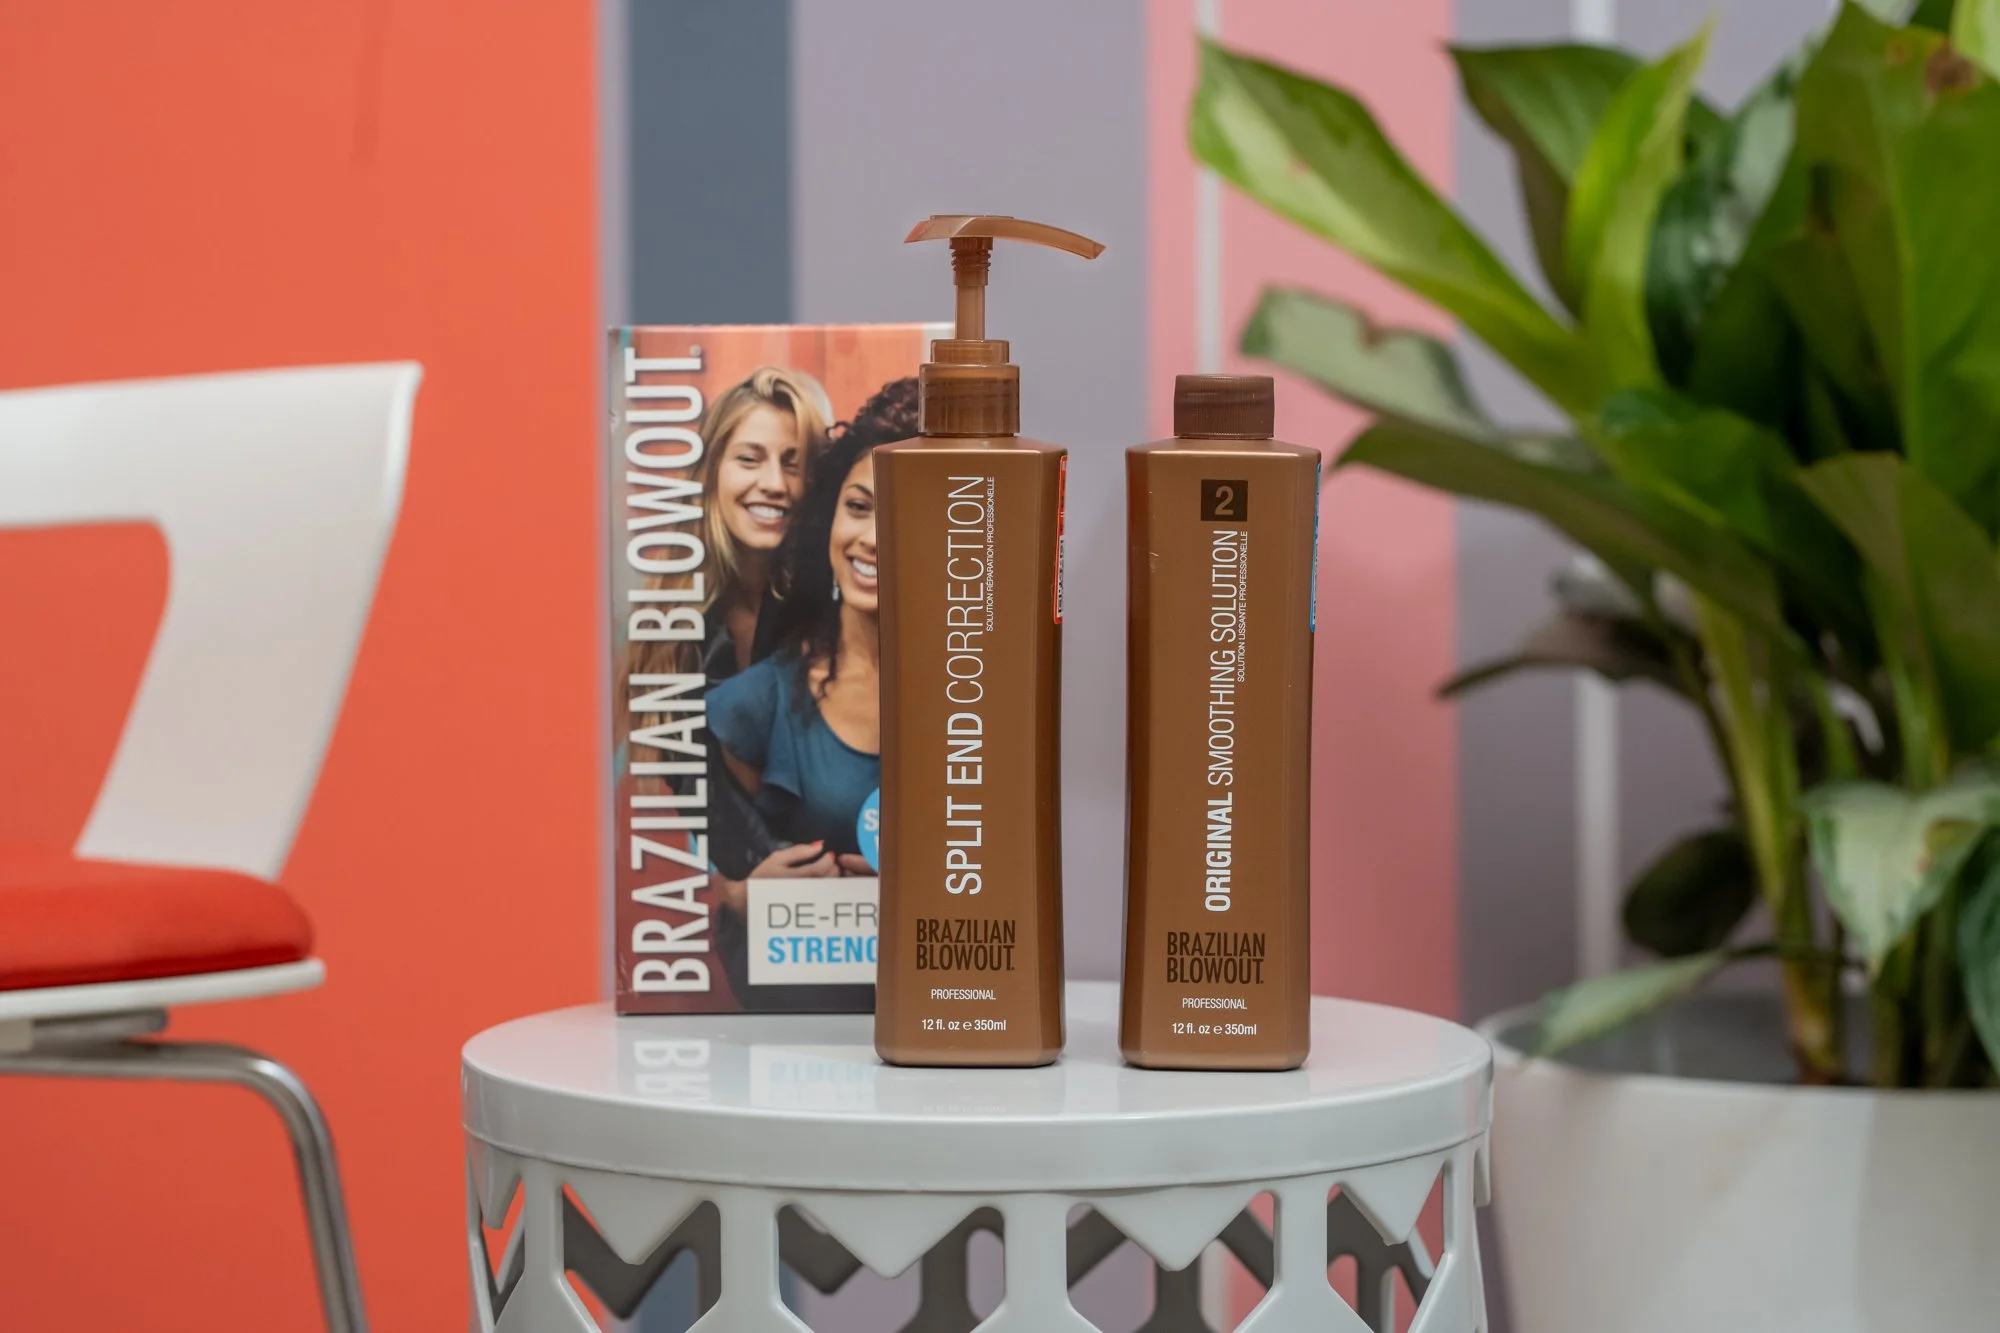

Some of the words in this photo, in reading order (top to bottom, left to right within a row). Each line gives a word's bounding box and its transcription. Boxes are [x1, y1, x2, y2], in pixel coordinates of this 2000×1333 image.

[1213, 484, 1235, 516] 2
[986, 544, 995, 593] RÉPARATION
[1210, 530, 1238, 644] SOLUTION
[946, 476, 985, 704] CORRECTION
[986, 592, 994, 632] SOLUTION
[1238, 600, 1248, 641] LISSANTE
[1237, 641, 1246, 683] SOLUTION
[1207, 649, 1237, 786] SMOOTHING
[946, 712, 983, 785] END
[627, 672, 711, 993] BRAZILIAN
[945, 795, 983, 895] SPLIT
[1204, 791, 1234, 913] ORIGINAL
[916, 918, 1016, 944] BRAZILIAN
[1166, 931, 1266, 957] BRAZILIAN
[930, 988, 997, 1001] PROFESSIONAL
[1182, 997, 1248, 1010] PROFESSIONAL
[921, 1018, 934, 1030] 12
[936, 1018, 946, 1030] fl.
[948, 1020, 960, 1031] oz
[974, 1019, 1007, 1031] 350ml
[1171, 1022, 1185, 1034] 12
[1186, 1022, 1196, 1034] fl.
[1198, 1024, 1211, 1035] oz
[1224, 1023, 1257, 1036] 350ml
